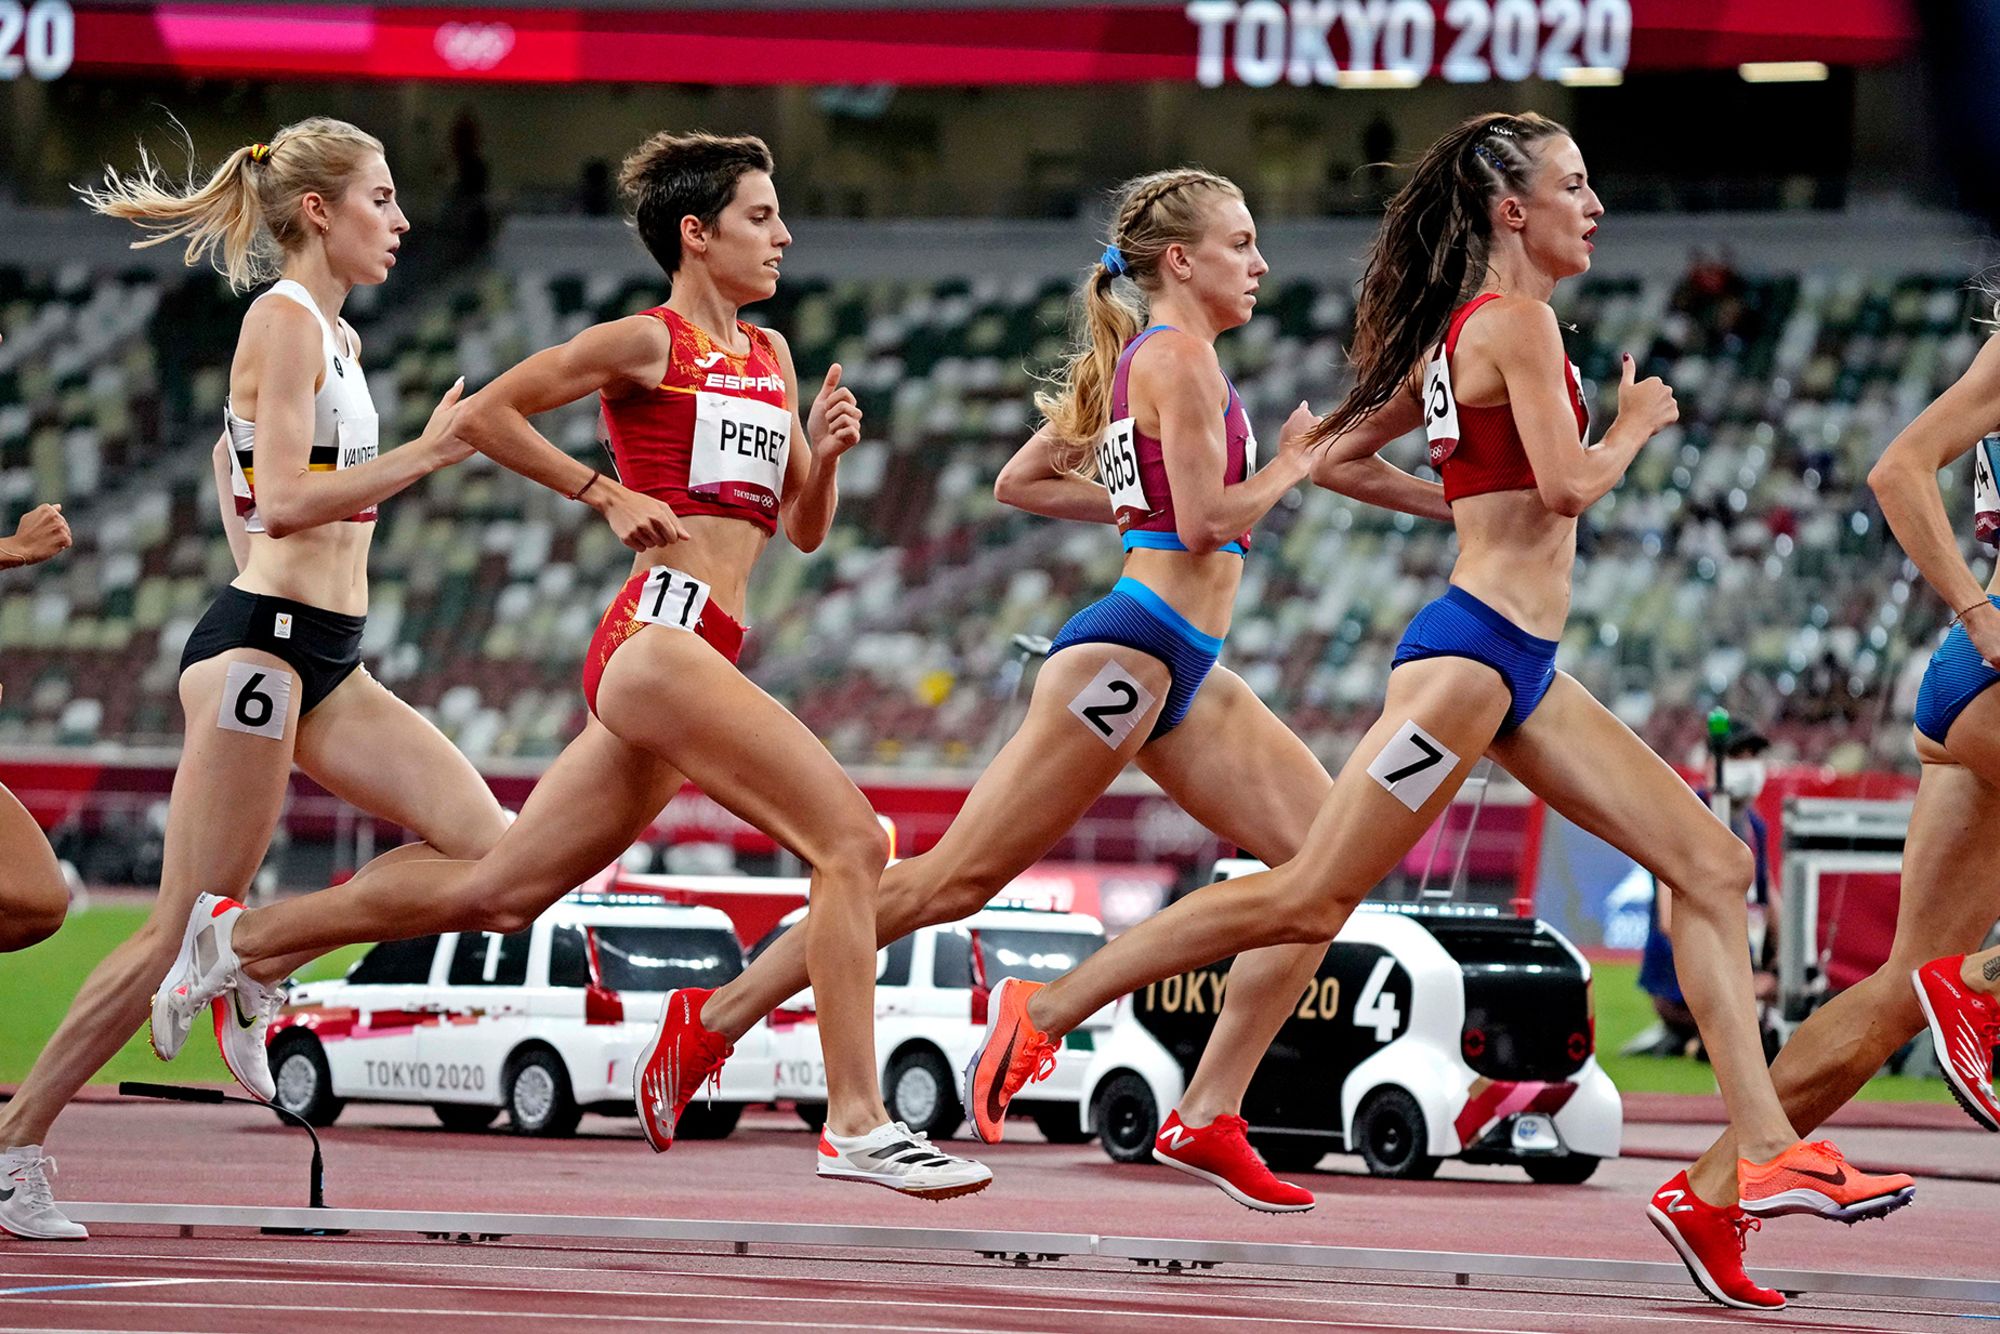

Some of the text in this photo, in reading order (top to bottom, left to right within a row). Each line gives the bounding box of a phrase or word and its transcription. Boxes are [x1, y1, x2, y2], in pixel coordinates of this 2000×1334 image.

[1187, 0, 1633, 88] TOKYO 2020
[719, 418, 786, 467] PEREZ
[1096, 432, 1136, 494] 865
[652, 570, 700, 627] 11
[234, 672, 274, 728] 6
[1082, 680, 1139, 737] 2
[1383, 732, 1444, 784] 7
[481, 931, 505, 982] 1
[1145, 970, 1341, 1021] TOKY 20
[1352, 955, 1401, 1043] 4
[364, 1060, 486, 1091] TOKYO 2020
